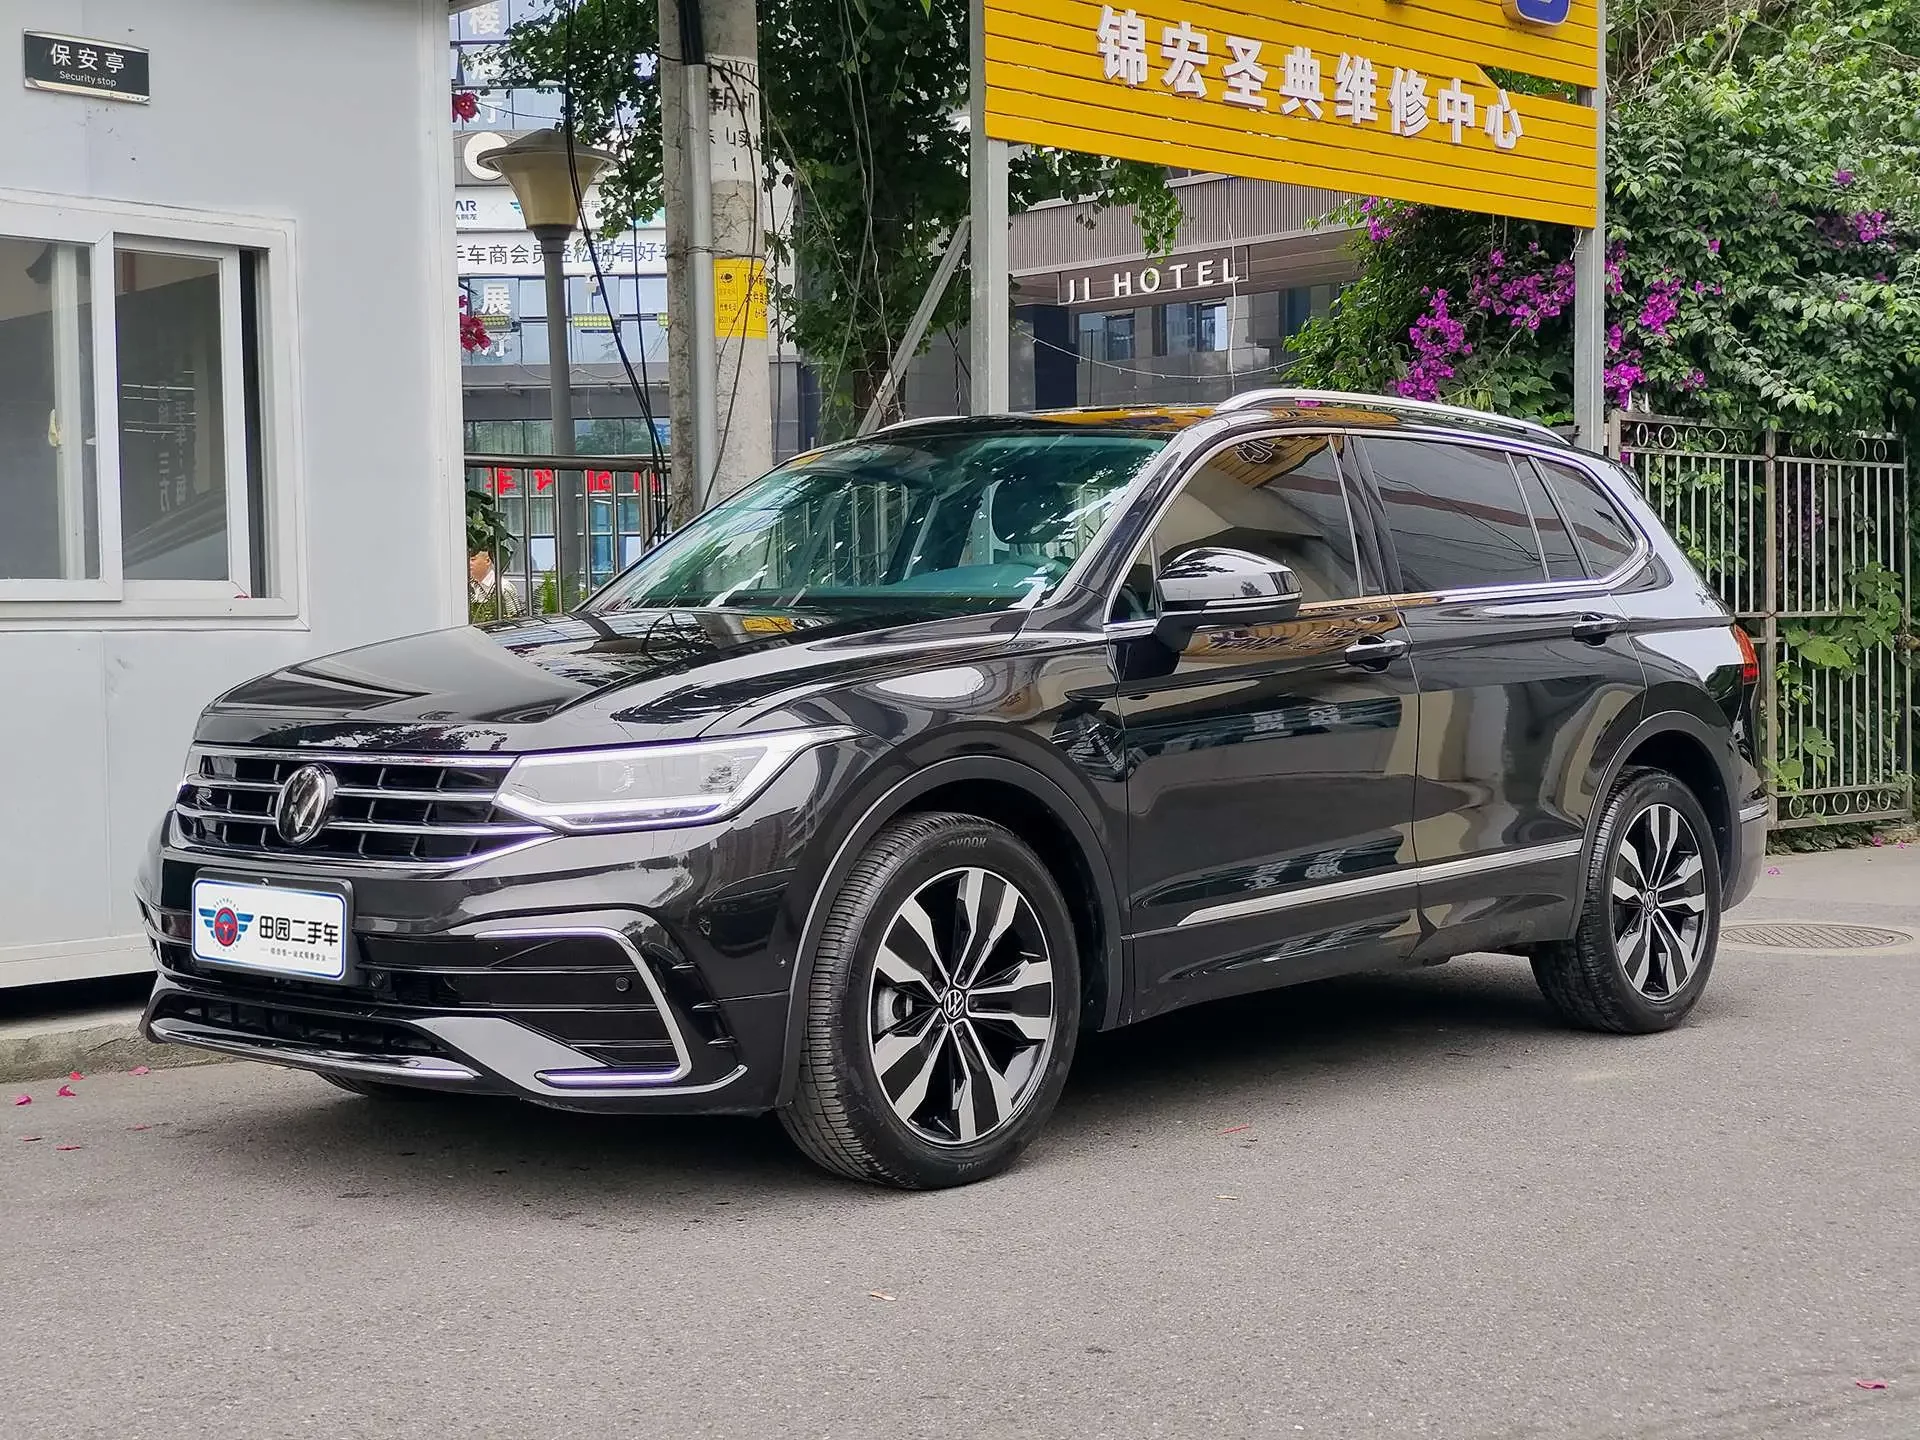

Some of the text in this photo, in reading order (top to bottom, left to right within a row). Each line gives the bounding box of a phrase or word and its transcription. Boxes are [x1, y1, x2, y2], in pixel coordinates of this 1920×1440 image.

[50, 43, 125, 74] 保安亭
[59, 70, 117, 87] Security stop
[1097, 7, 1523, 150] 锦宏圣典维修中心
[1067, 257, 1240, 303] JI HOTEL
[260, 915, 339, 946] 田园二手车
